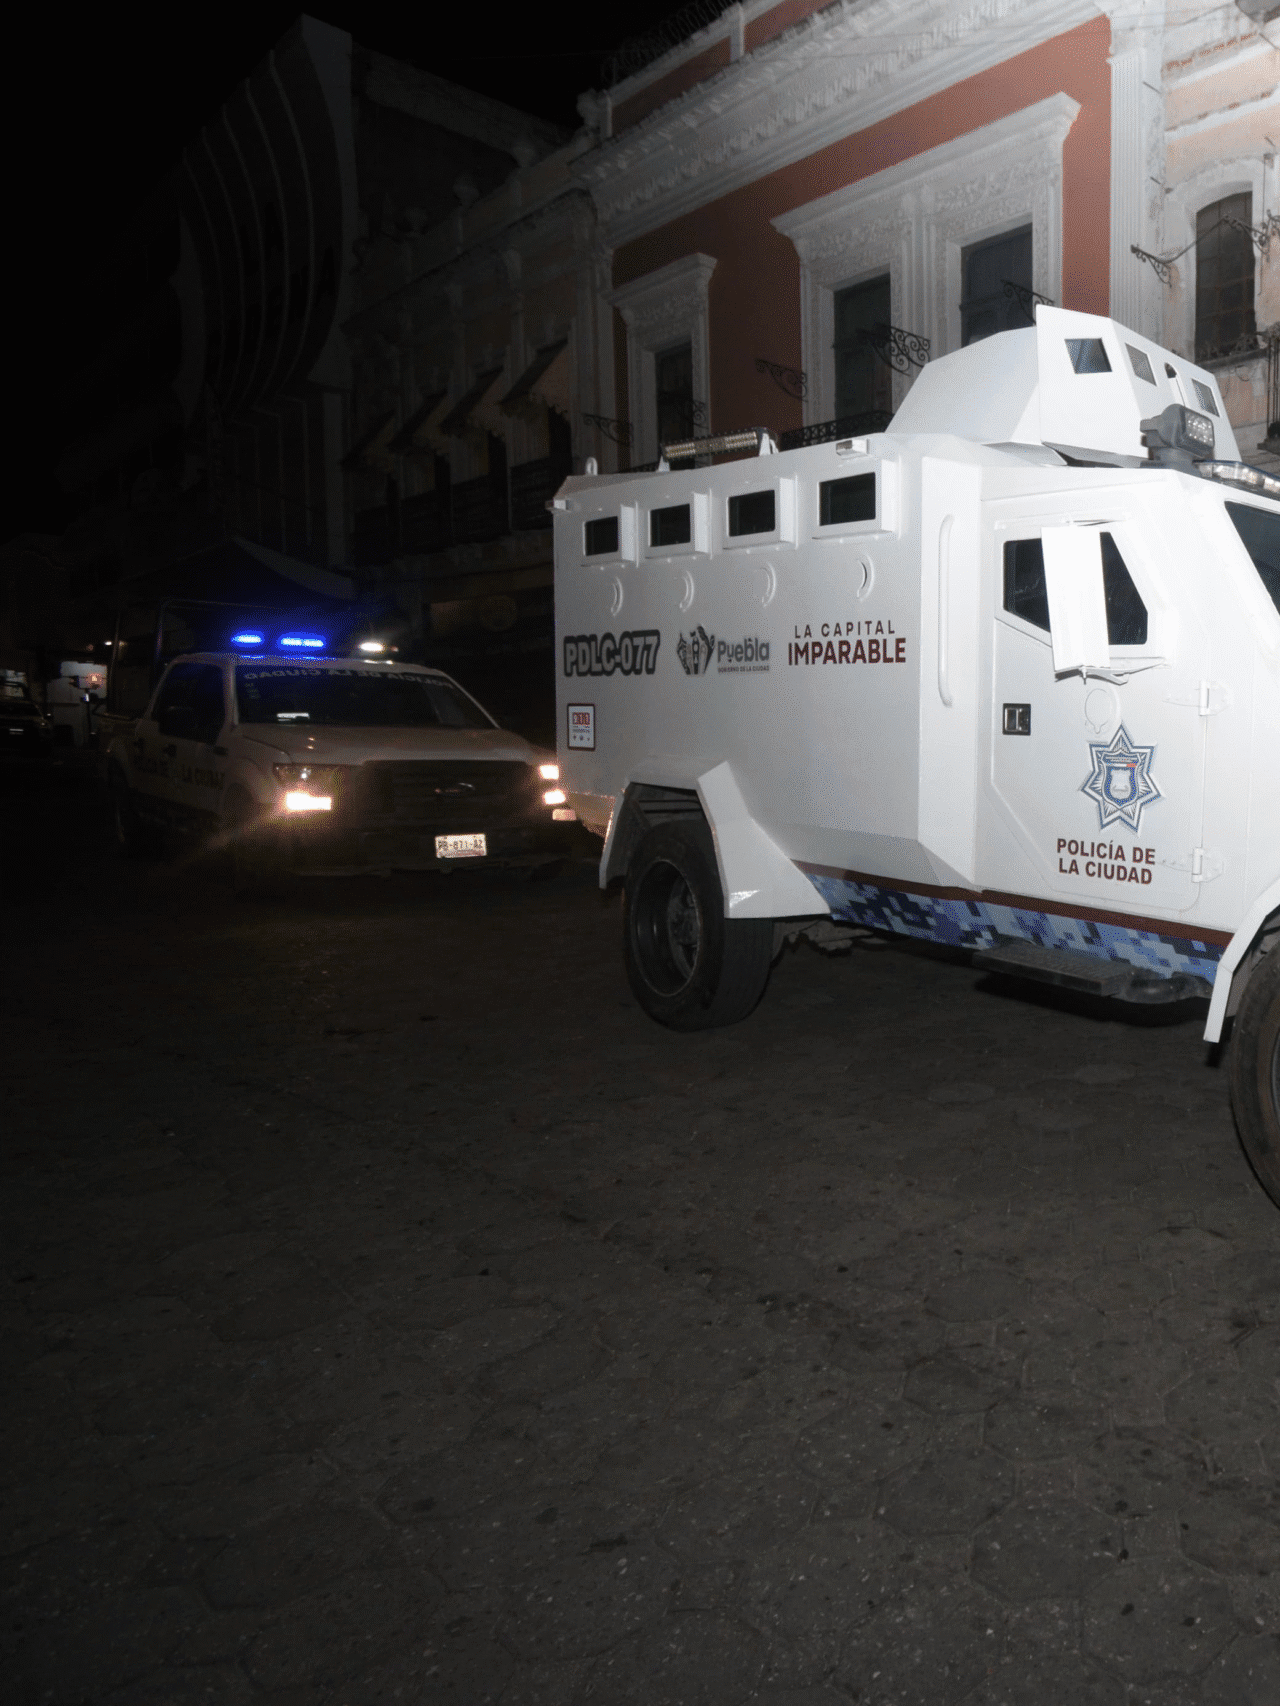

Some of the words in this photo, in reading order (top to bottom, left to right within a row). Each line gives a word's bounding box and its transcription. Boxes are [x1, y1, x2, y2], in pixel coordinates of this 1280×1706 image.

[794, 624, 812, 639] LA
[821, 619, 896, 637] CAPITAL
[563, 629, 660, 677] PDLC-077
[717, 637, 769, 663] Puebla
[788, 637, 906, 666] IMPARABLE
[1056, 838, 1126, 862] POLICÍA
[1132, 846, 1156, 865] DE
[1058, 858, 1080, 876] LA
[1085, 861, 1153, 885] CIUDAD
